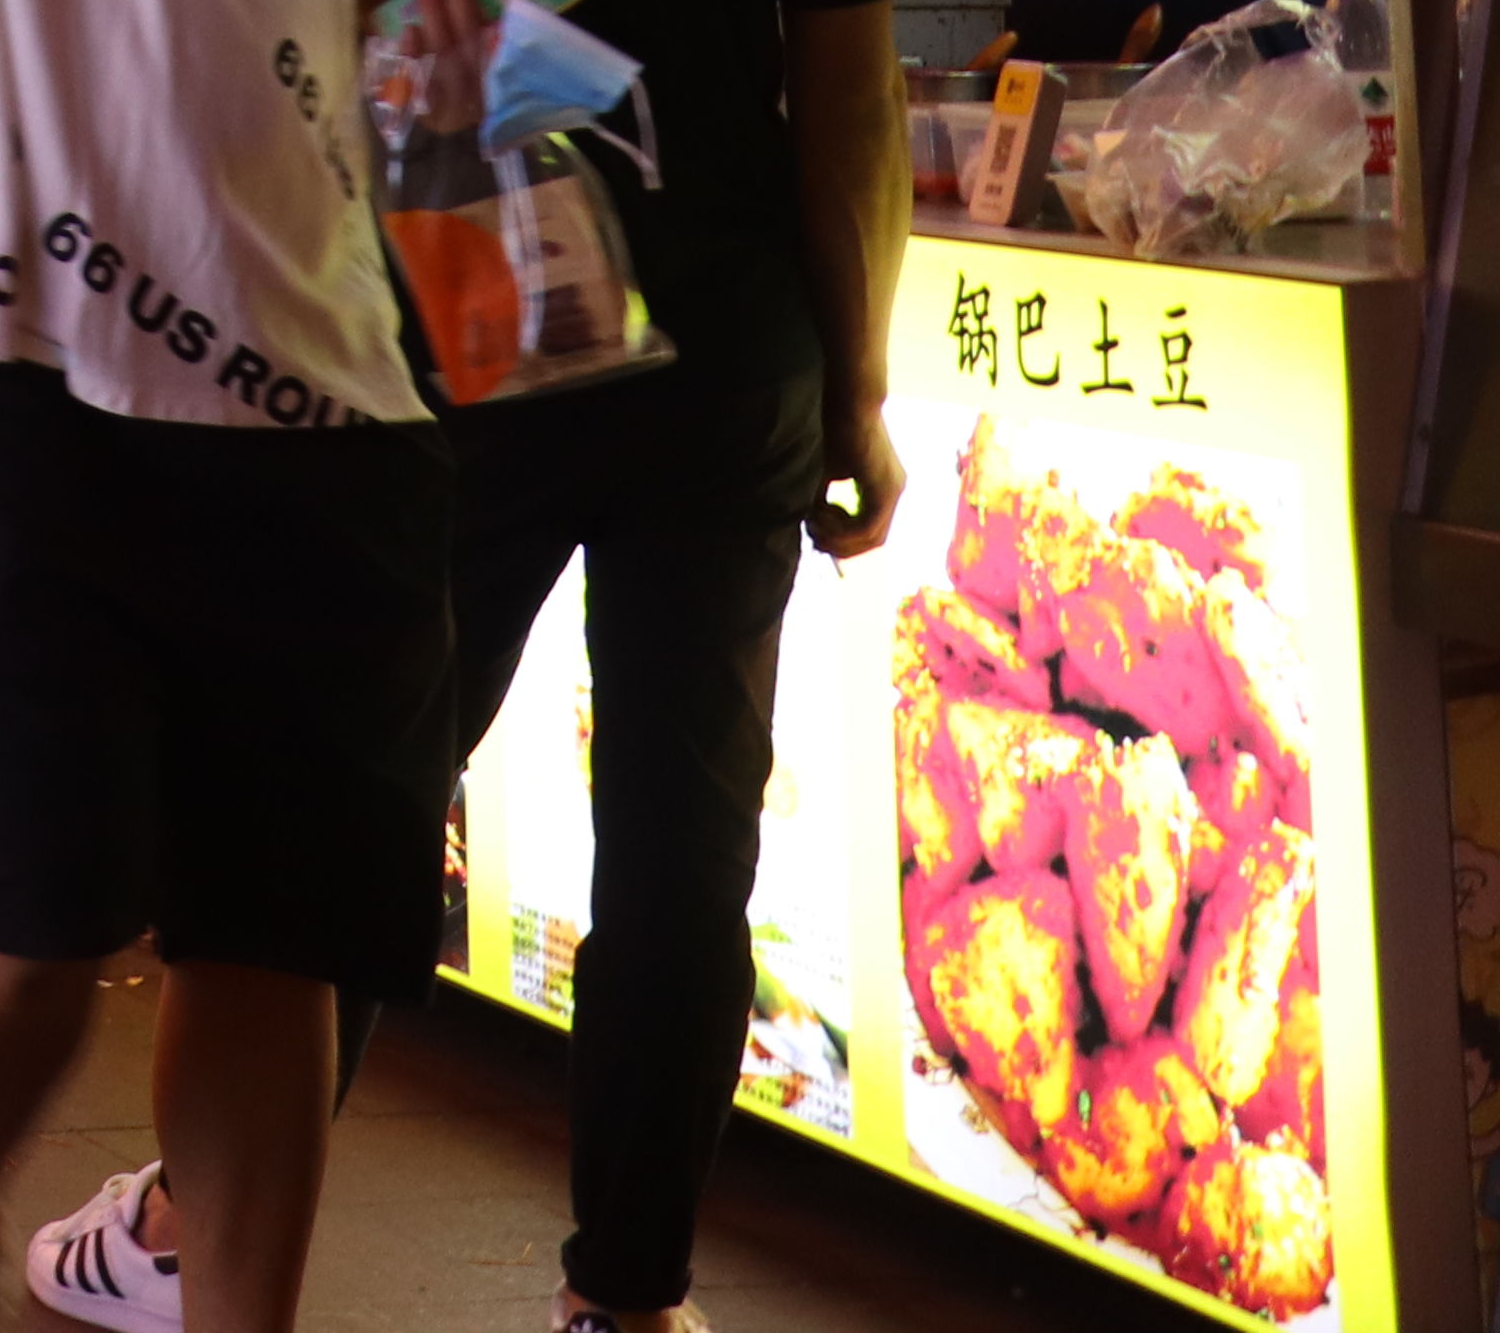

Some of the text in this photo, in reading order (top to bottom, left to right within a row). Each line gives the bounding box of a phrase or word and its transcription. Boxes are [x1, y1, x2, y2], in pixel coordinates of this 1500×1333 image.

[43, 211, 366, 430] 66 US ROU
[947, 272, 1210, 413] 锅巴土豆
